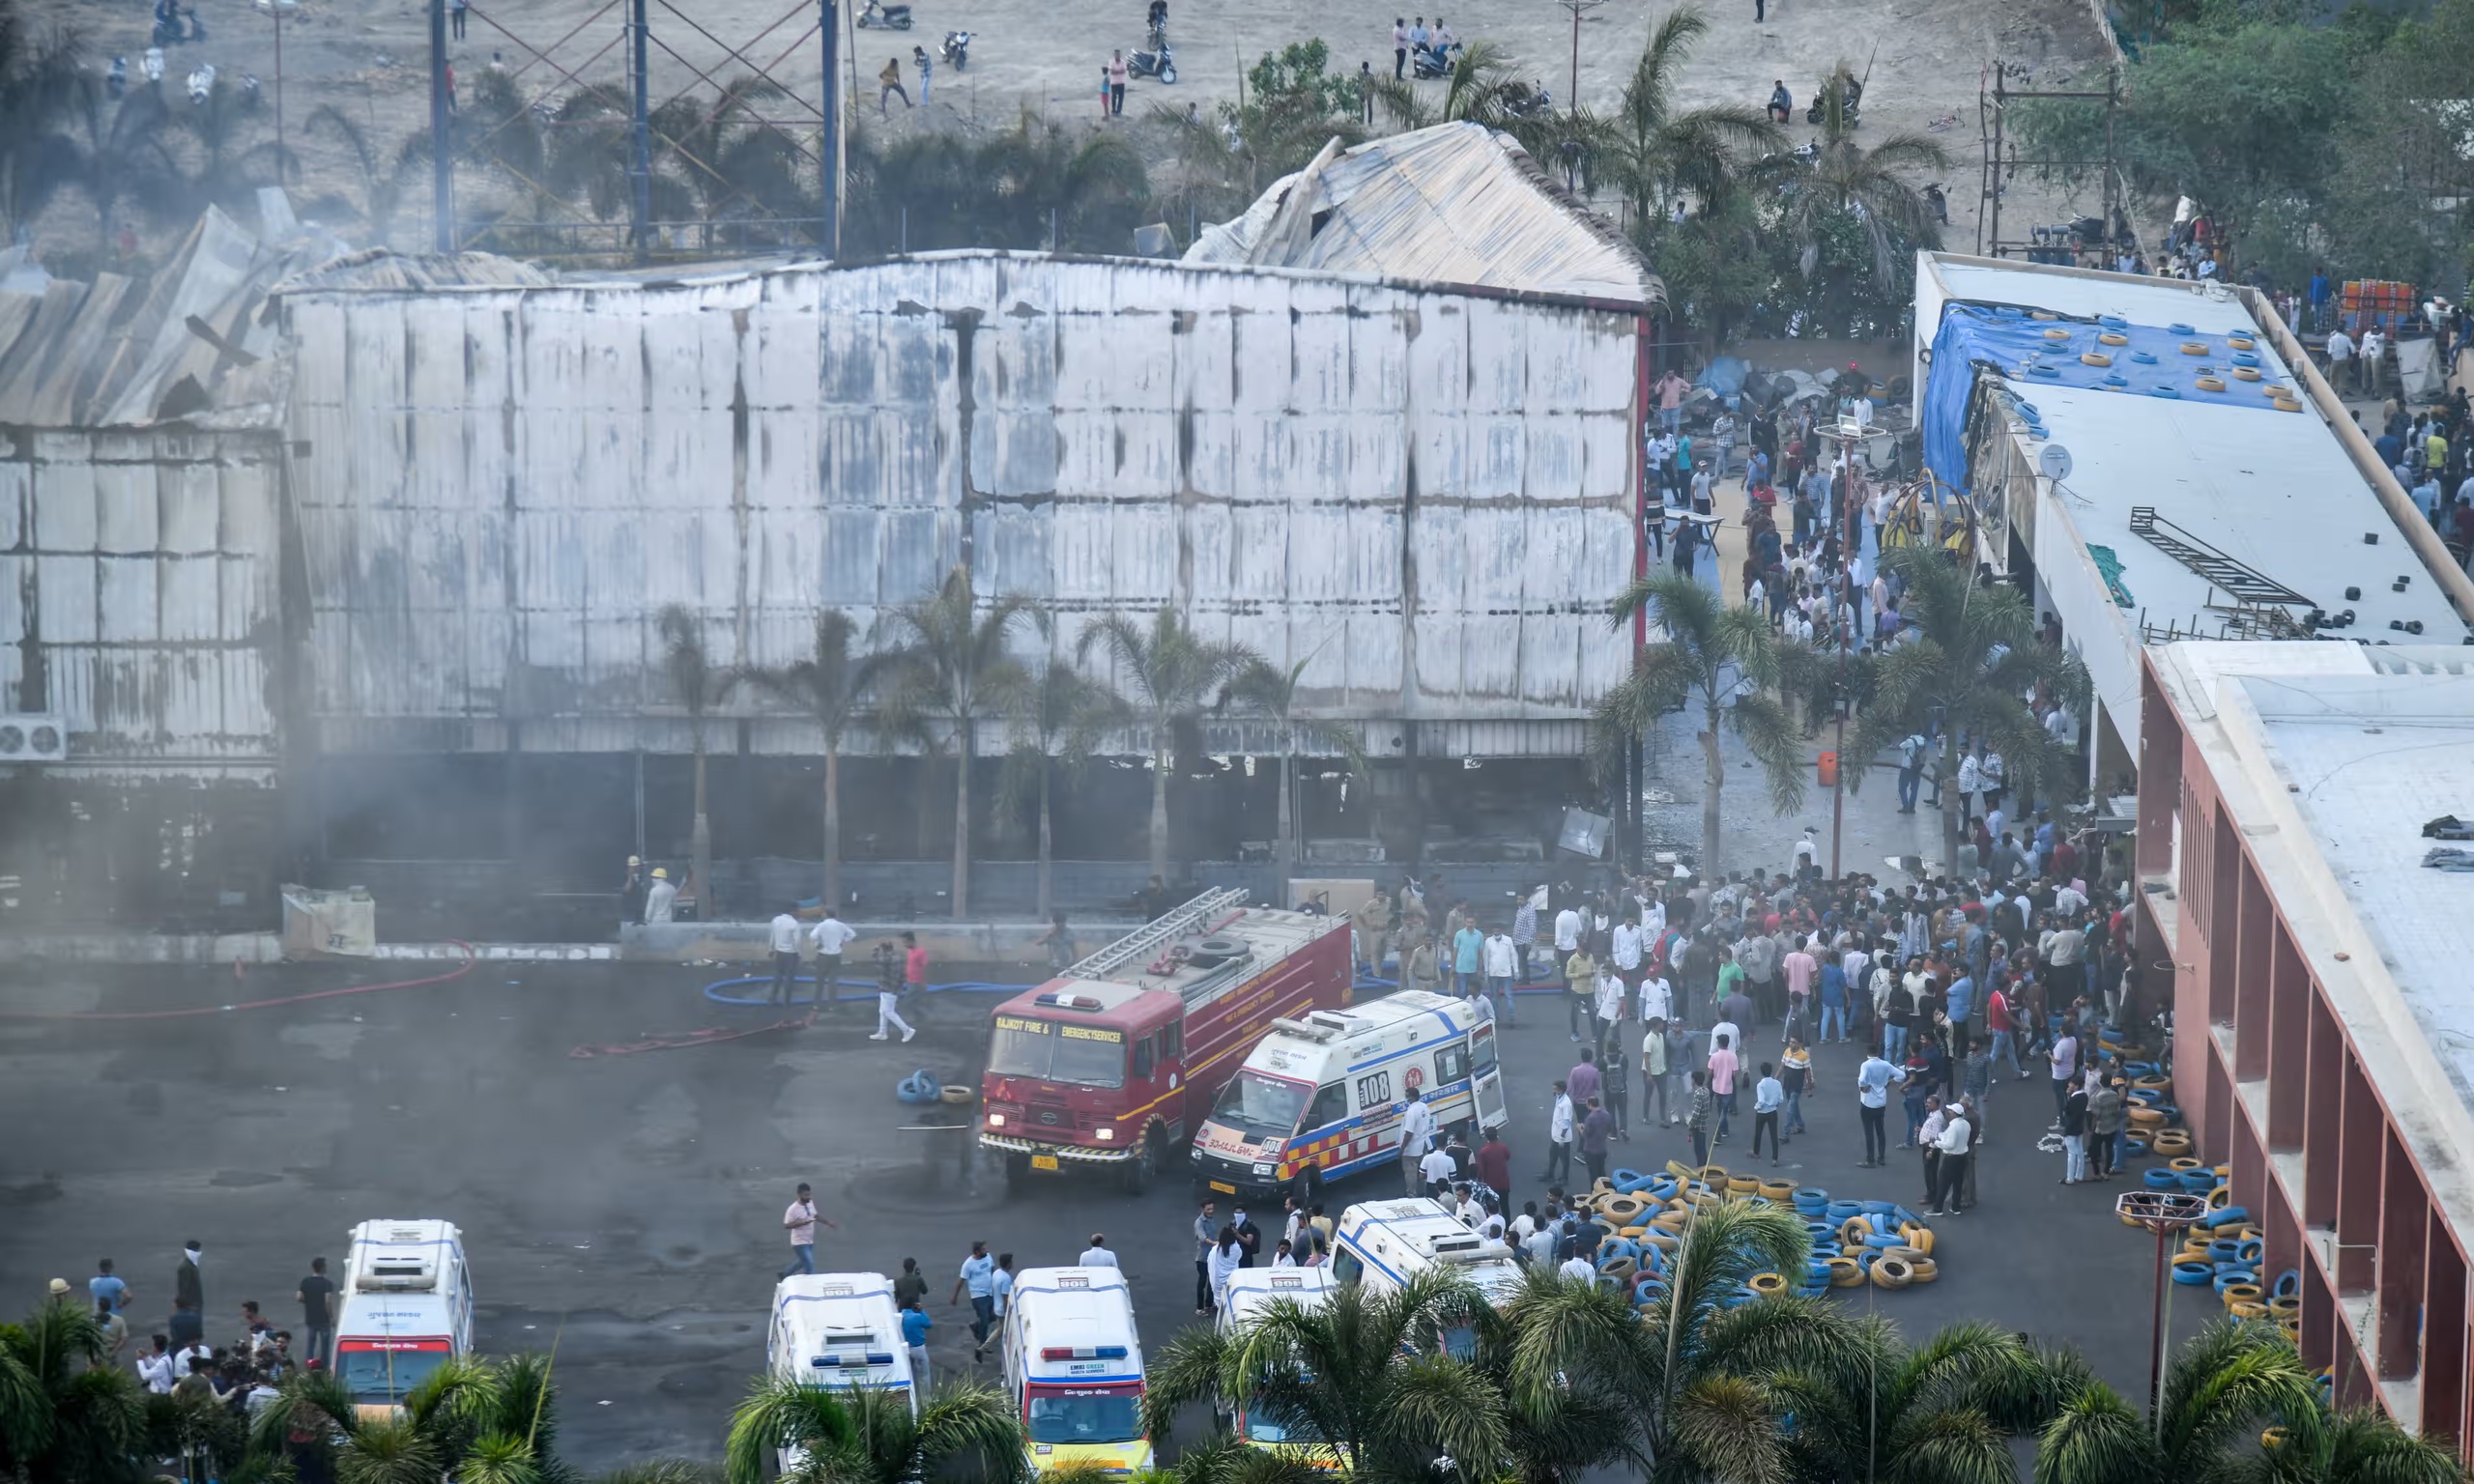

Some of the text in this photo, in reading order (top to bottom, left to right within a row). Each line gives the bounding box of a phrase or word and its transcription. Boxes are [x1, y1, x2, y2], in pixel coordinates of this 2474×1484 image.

[996, 1017, 1023, 1031] RAJKOT
[1024, 1021, 1042, 1034] FIRE
[1043, 1024, 1050, 1035] &
[1361, 1072, 1390, 1106] 108
[1265, 1140, 1282, 1154] 108
